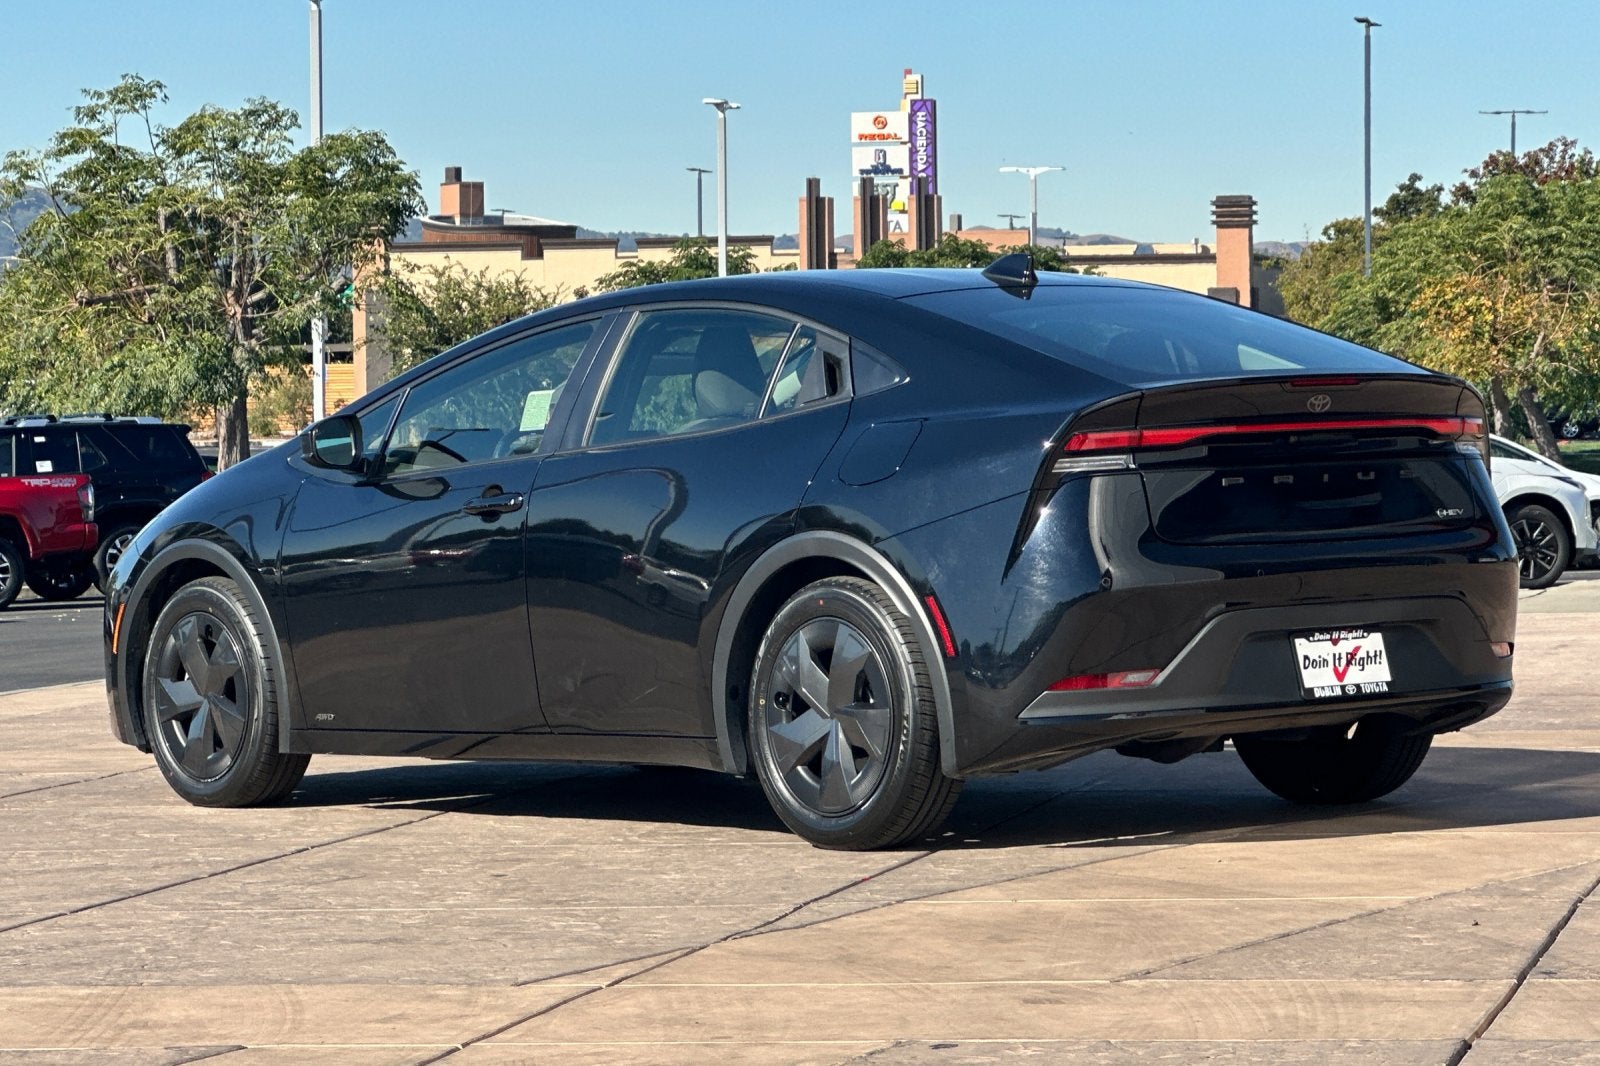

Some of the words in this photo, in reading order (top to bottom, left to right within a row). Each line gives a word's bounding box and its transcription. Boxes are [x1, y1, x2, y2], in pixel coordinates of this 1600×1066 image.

[916, 111, 927, 171] HACIENDA
[1333, 653, 1342, 667] It
[1346, 650, 1382, 671] Right!
[1313, 686, 1342, 698] DUBLIN
[1360, 682, 1388, 693] TOYOTA
